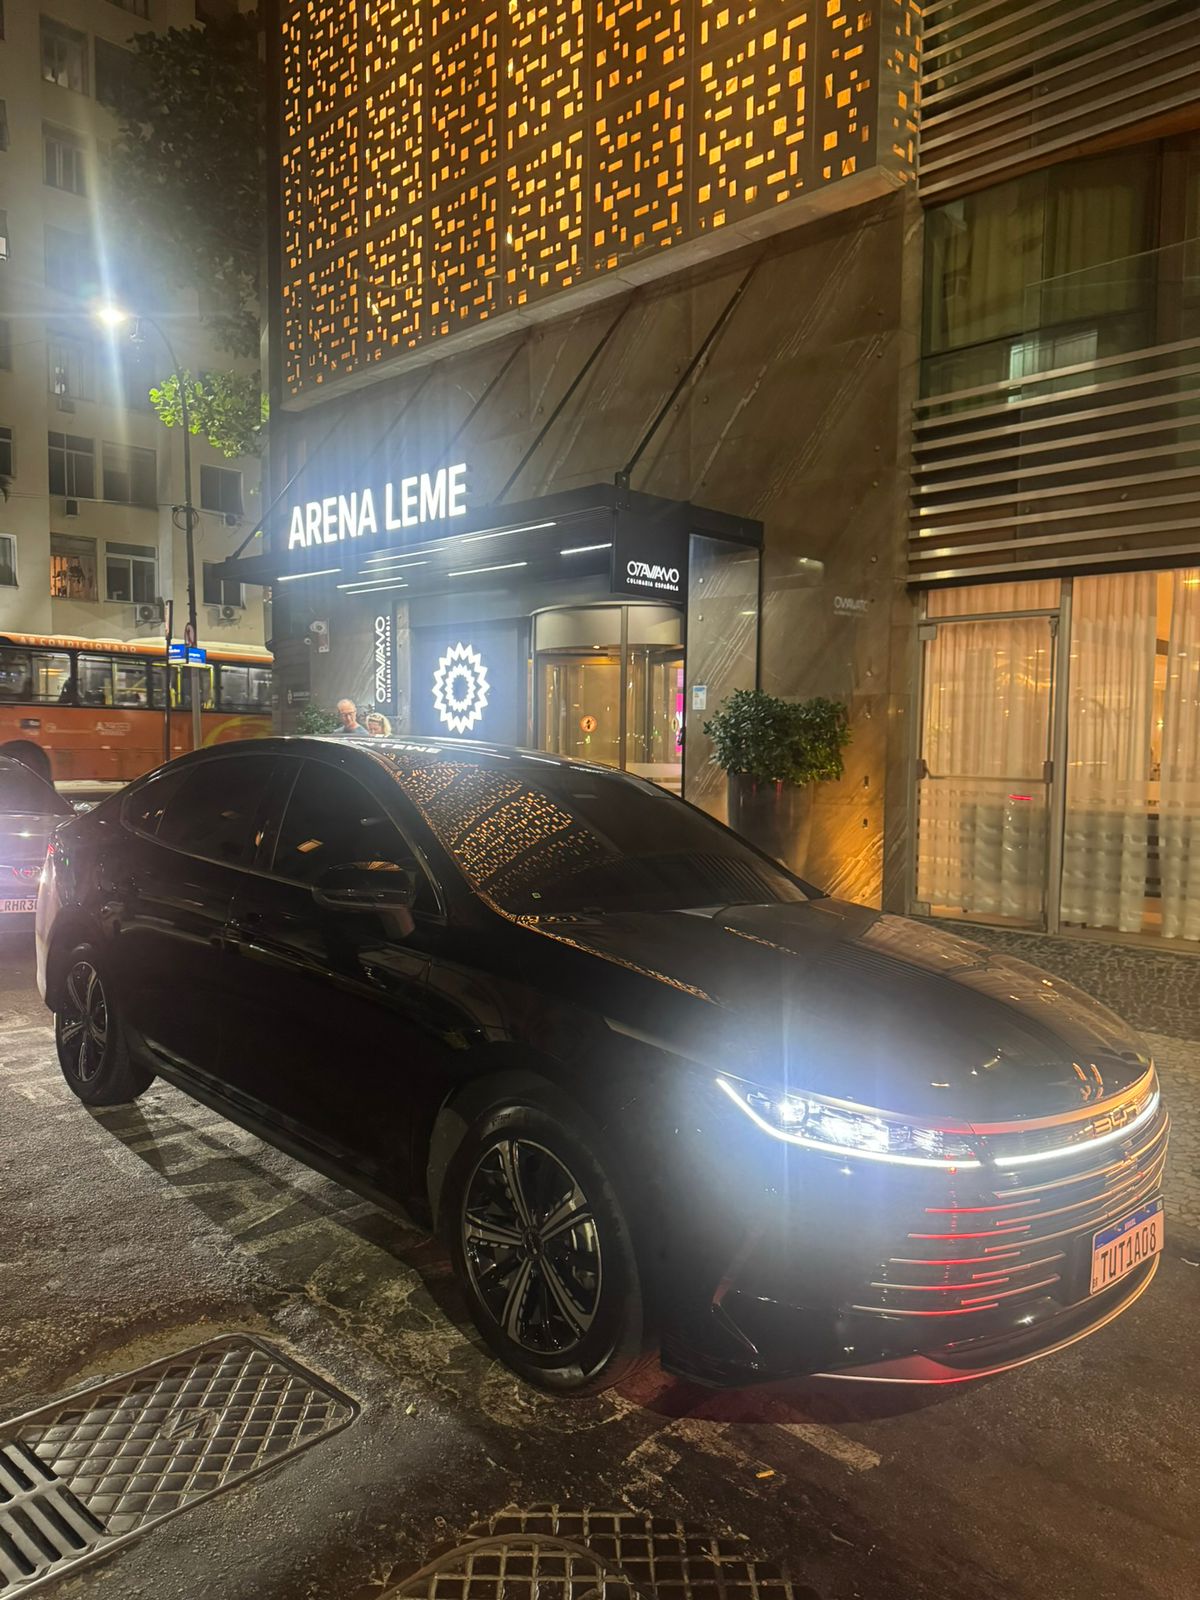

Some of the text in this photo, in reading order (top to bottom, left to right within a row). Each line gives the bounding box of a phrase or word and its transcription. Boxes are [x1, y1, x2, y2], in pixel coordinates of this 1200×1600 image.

[288, 462, 467, 550] ARENA LEME
[626, 577, 654, 588] CULINARIA
[627, 560, 680, 583] OTAVIANO
[40, 639, 137, 653] CONDICIONADO
[375, 616, 386, 703] OTAVIANO
[1101, 1222, 1157, 1283] TUT1A08
